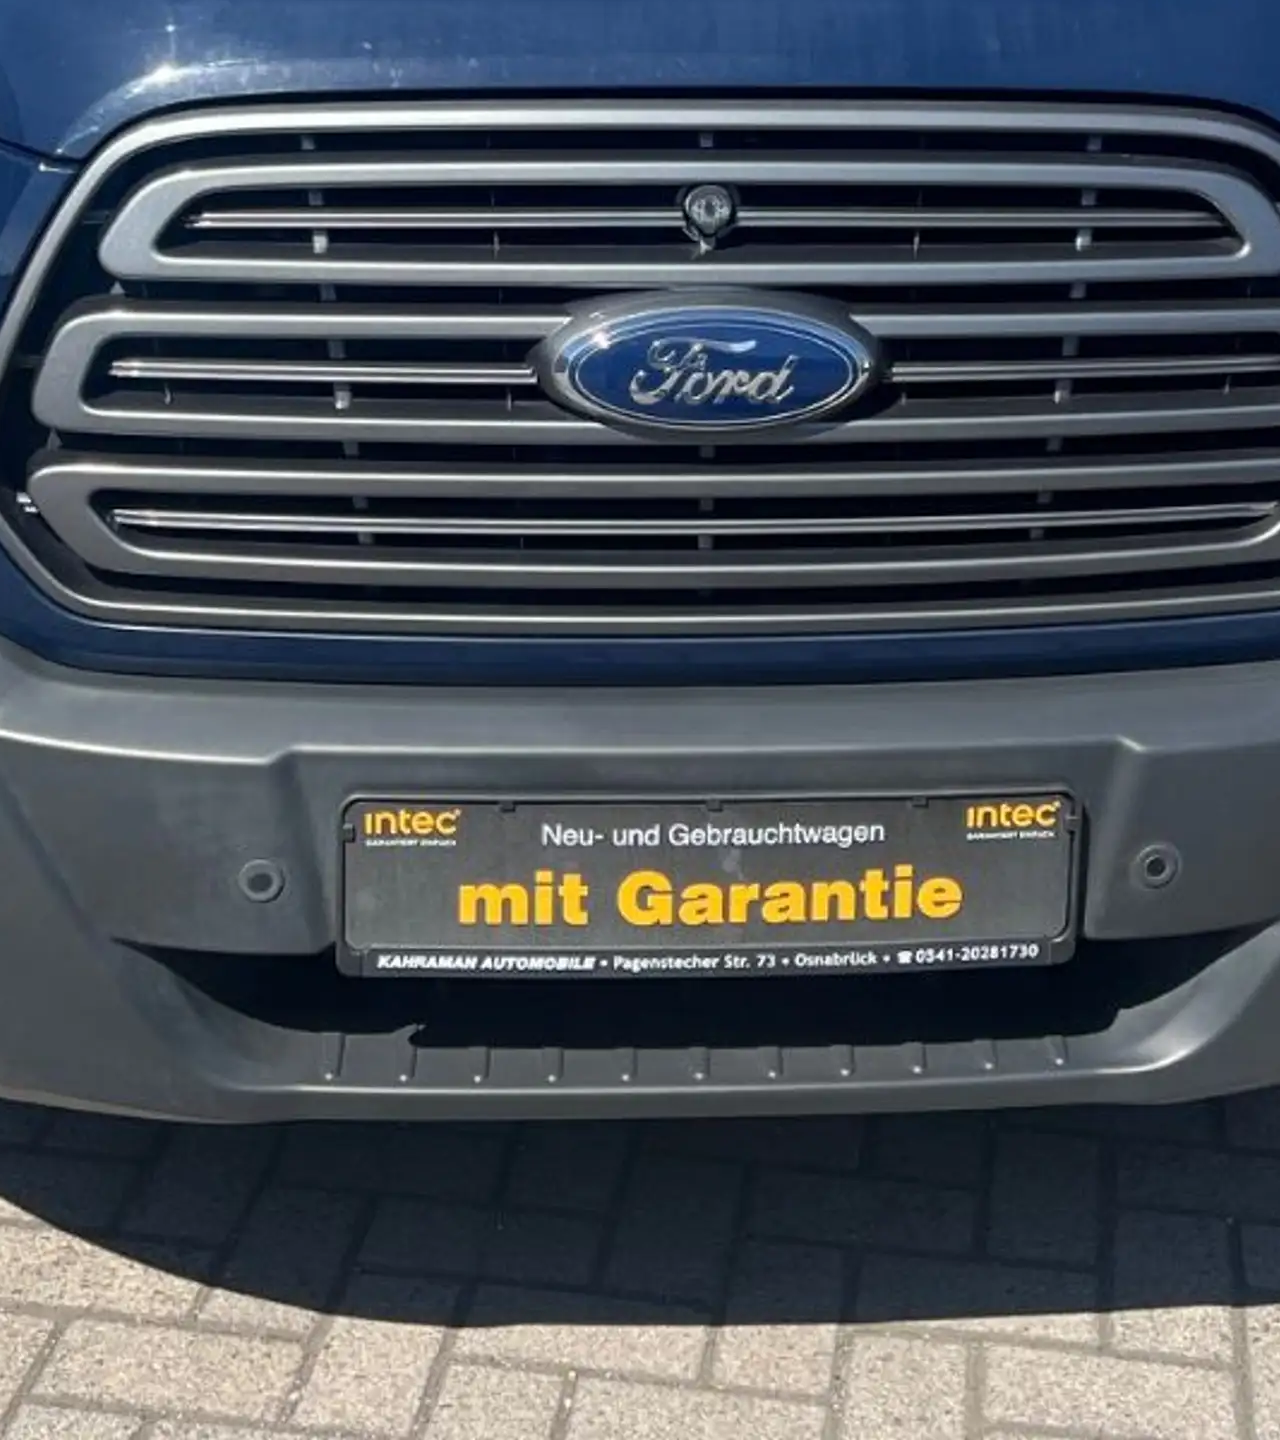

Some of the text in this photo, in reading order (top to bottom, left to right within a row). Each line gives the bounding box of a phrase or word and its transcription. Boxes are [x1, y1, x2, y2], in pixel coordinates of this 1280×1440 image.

[629, 336, 799, 405] Ford
[364, 808, 458, 835] intec
[966, 802, 1057, 829] intec
[541, 821, 885, 848] Neu- und Gebrauchtwagen
[459, 864, 963, 926] mit Garantie
[377, 955, 476, 969] KAHRAMAN
[480, 956, 597, 971] AUTOMOBILE
[613, 955, 717, 972] Pagenstecher
[723, 955, 751, 969] Str.
[757, 954, 776, 968] 73
[794, 951, 877, 968] Osnabrück
